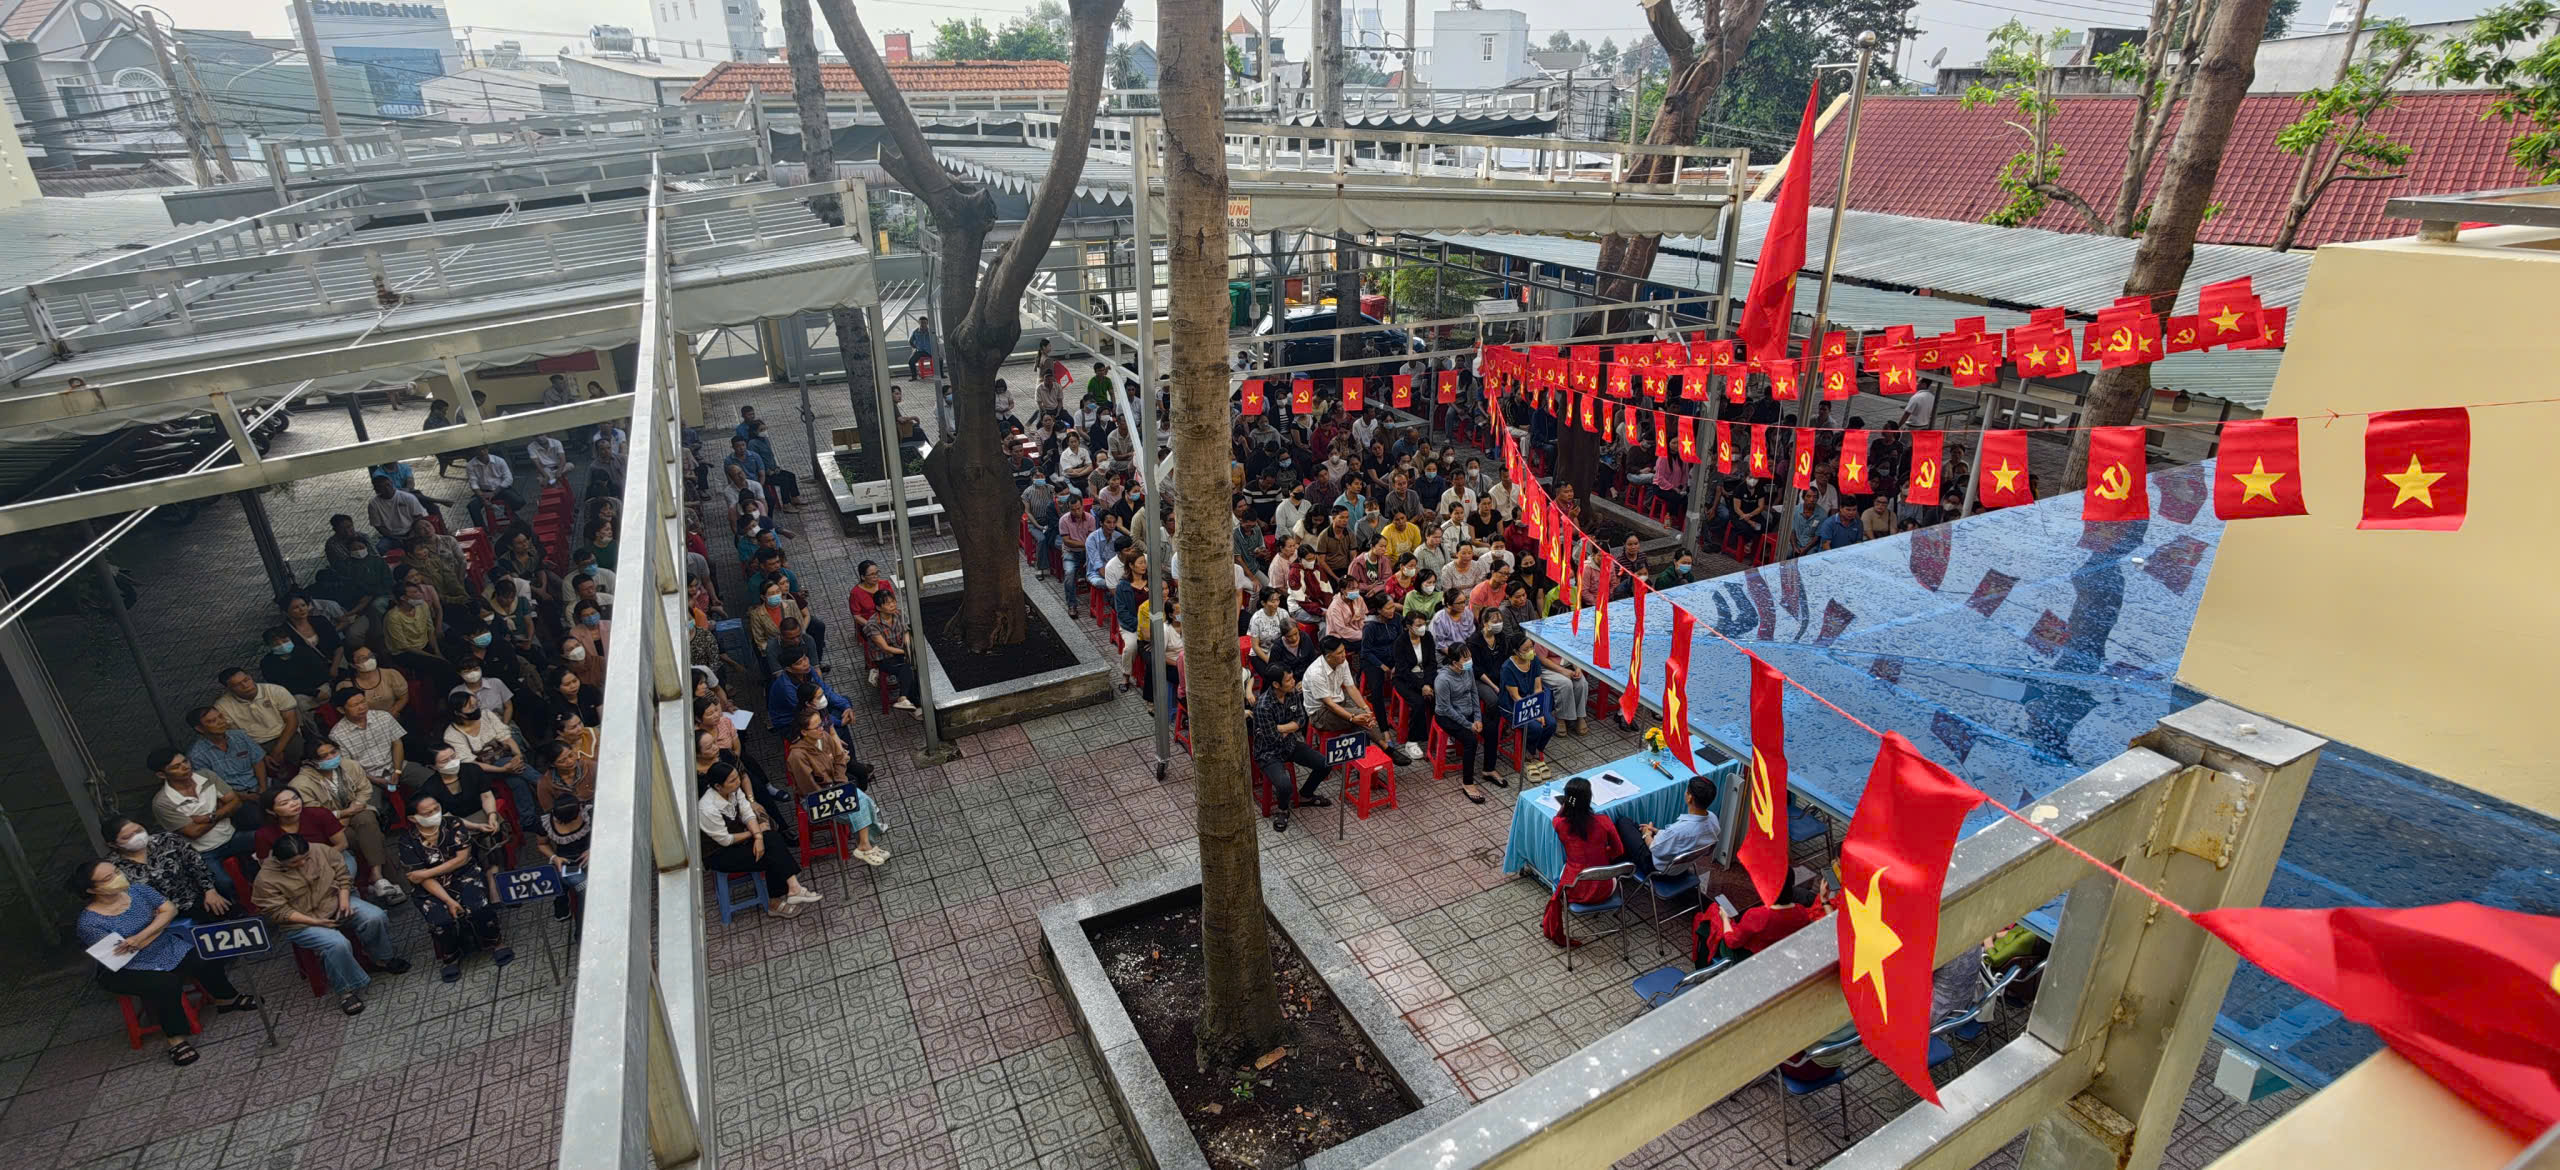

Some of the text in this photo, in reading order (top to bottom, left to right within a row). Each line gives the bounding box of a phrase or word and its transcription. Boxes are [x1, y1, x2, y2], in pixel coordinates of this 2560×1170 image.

[312, 1, 437, 19] EXIMBANK
[1236, 218, 1249, 227] 828
[1518, 704, 1541, 722] 12A5
[1328, 744, 1363, 763] 12A4
[811, 796, 857, 820] 12A3
[509, 880, 554, 900] 12A2
[199, 926, 264, 953] 12A1
